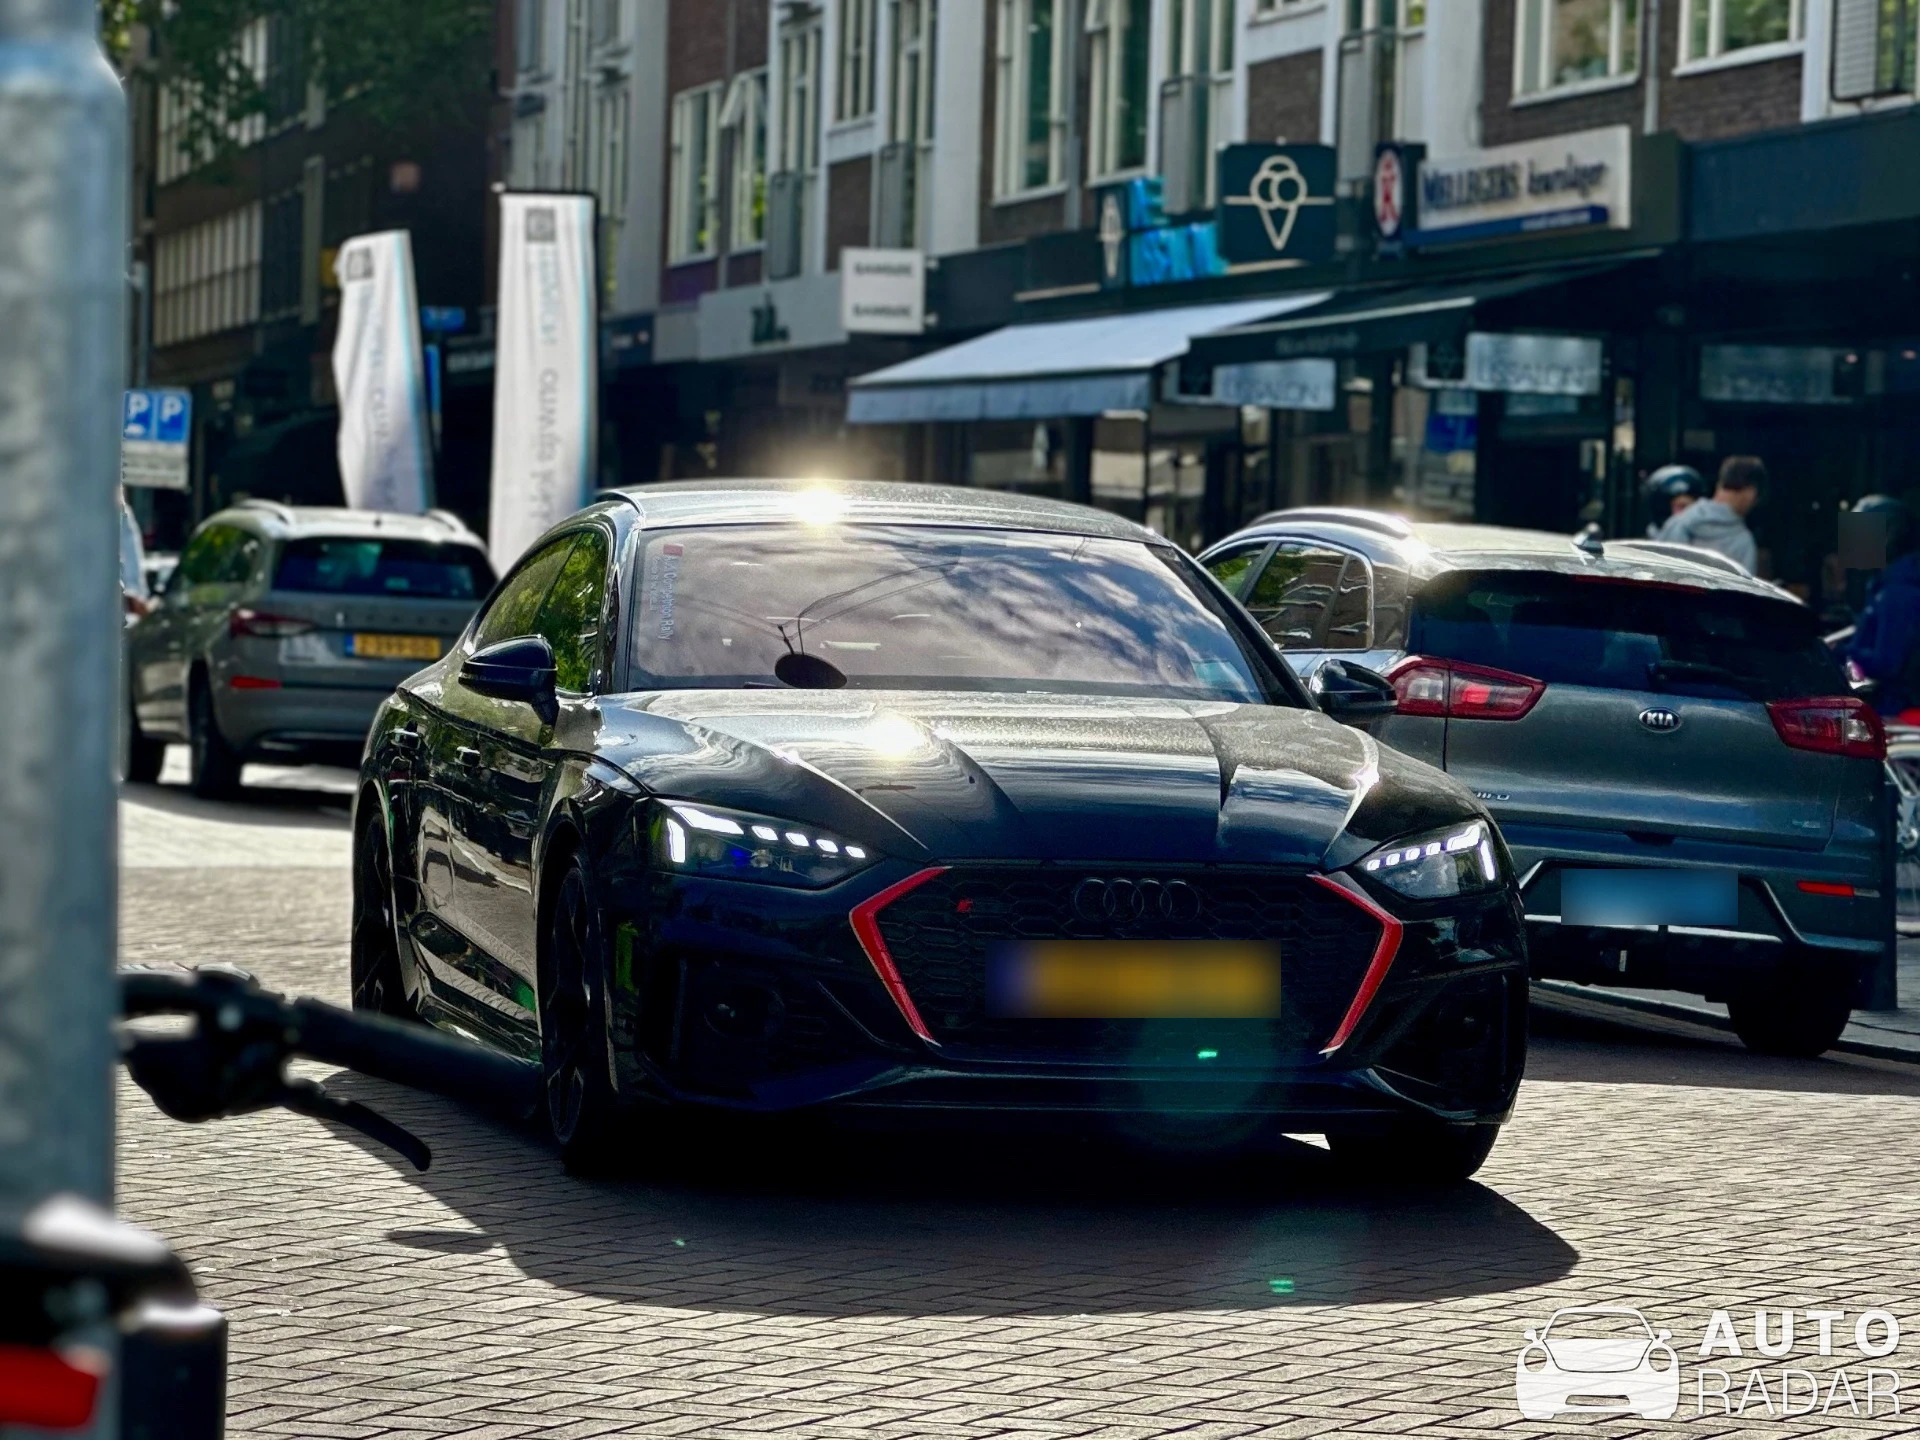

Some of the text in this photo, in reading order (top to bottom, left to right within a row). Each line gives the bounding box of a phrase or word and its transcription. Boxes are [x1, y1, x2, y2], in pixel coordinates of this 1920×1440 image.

[161, 396, 182, 422] P
[658, 620, 675, 640] Rally
[1646, 712, 1674, 726] KIA
